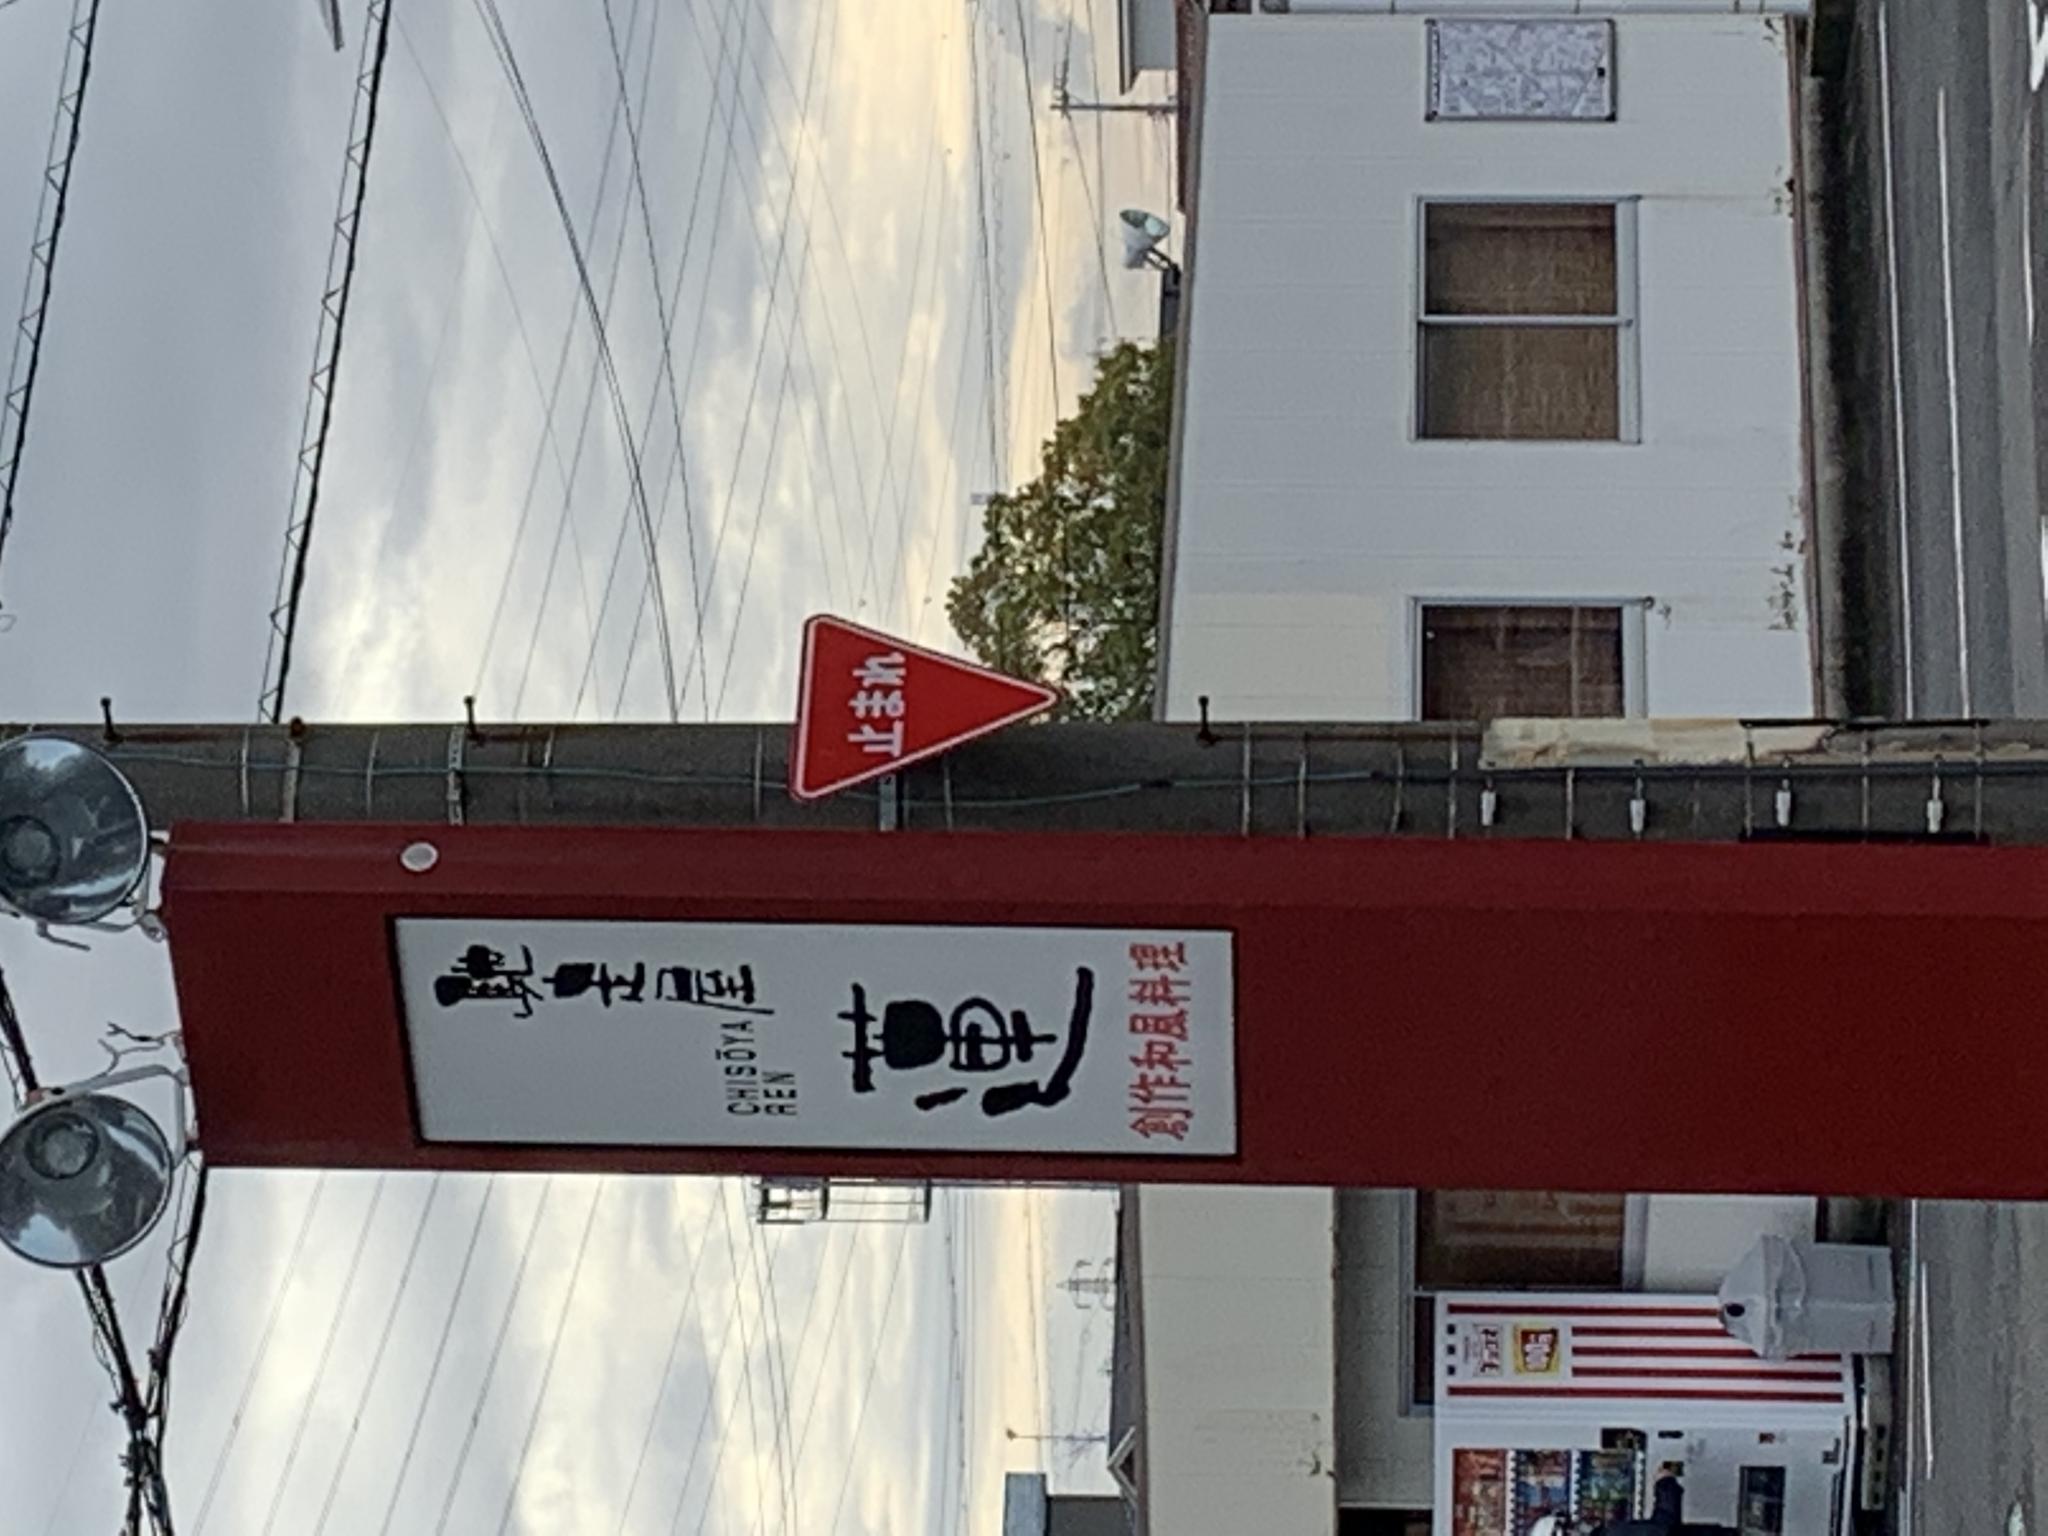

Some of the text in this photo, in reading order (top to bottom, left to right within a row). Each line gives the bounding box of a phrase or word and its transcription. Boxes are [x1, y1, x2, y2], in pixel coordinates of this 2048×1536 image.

[848, 652, 906, 758] 止まれ
[763, 1071, 798, 1116] REN
[837, 965, 1094, 1117] 蓮
[1128, 941, 1194, 1141] 創作和風料理
